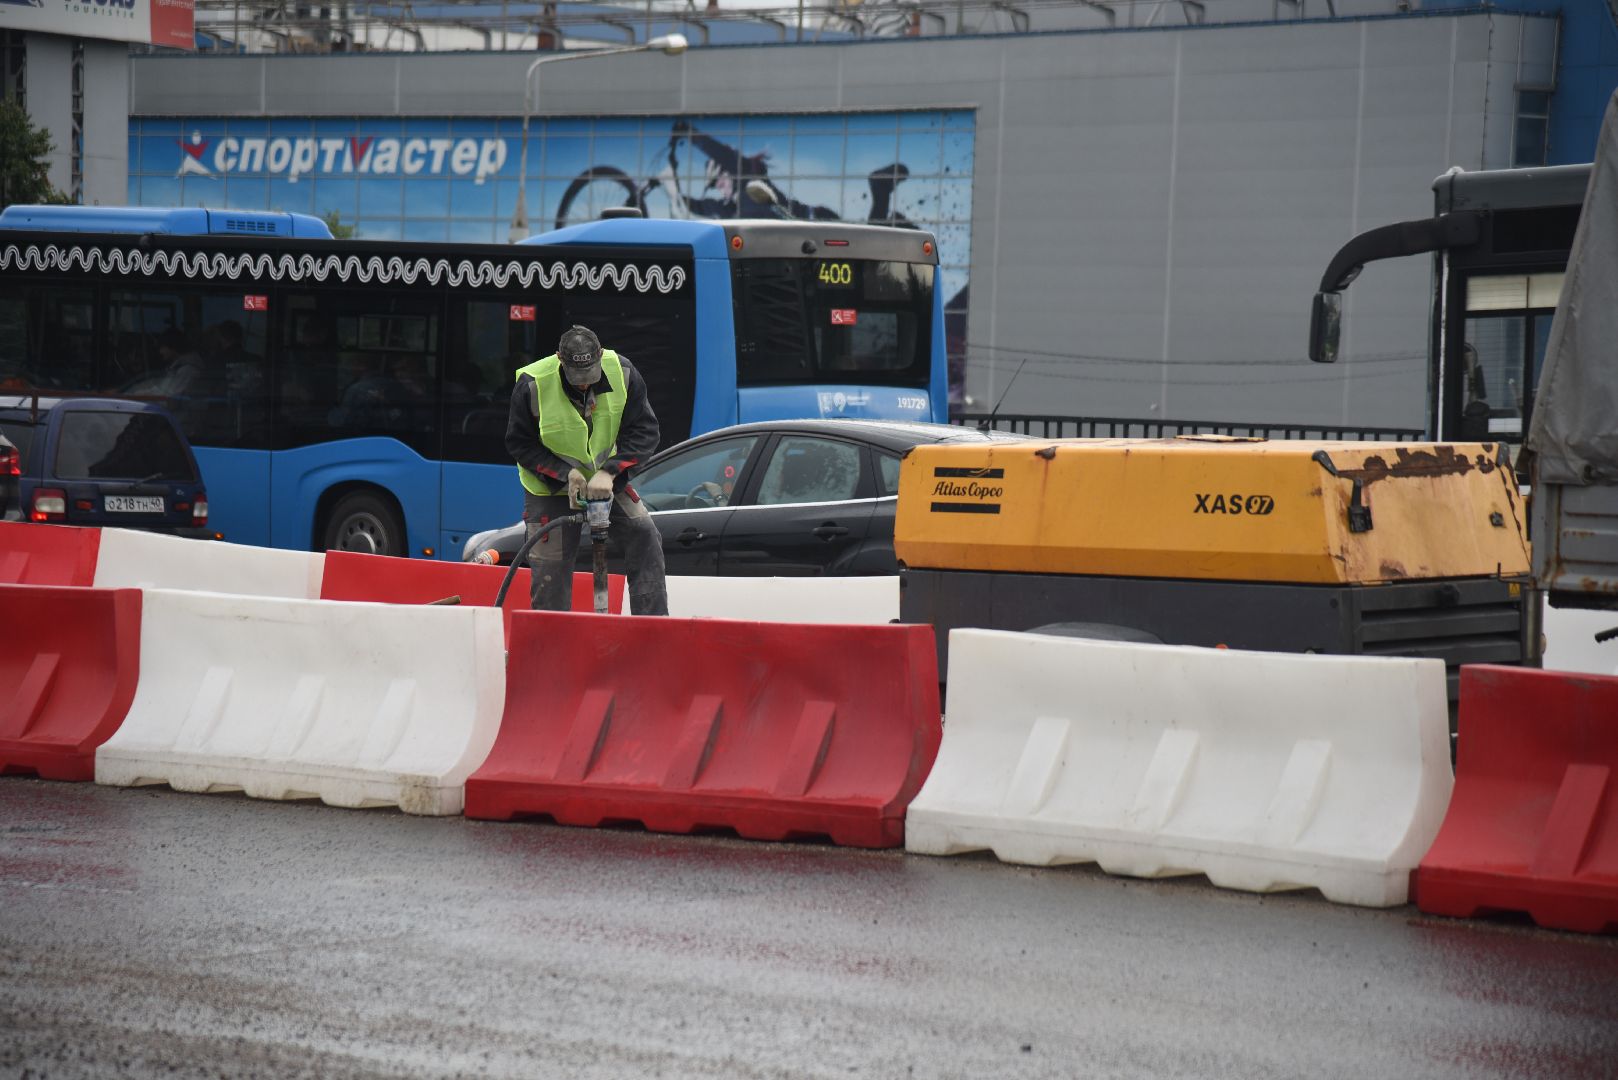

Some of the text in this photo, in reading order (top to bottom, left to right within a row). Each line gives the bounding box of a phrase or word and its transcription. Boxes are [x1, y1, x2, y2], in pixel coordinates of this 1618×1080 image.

[819, 263, 851, 284] 400
[897, 397, 926, 409] 191729
[931, 481, 1003, 500] Atlas Copco
